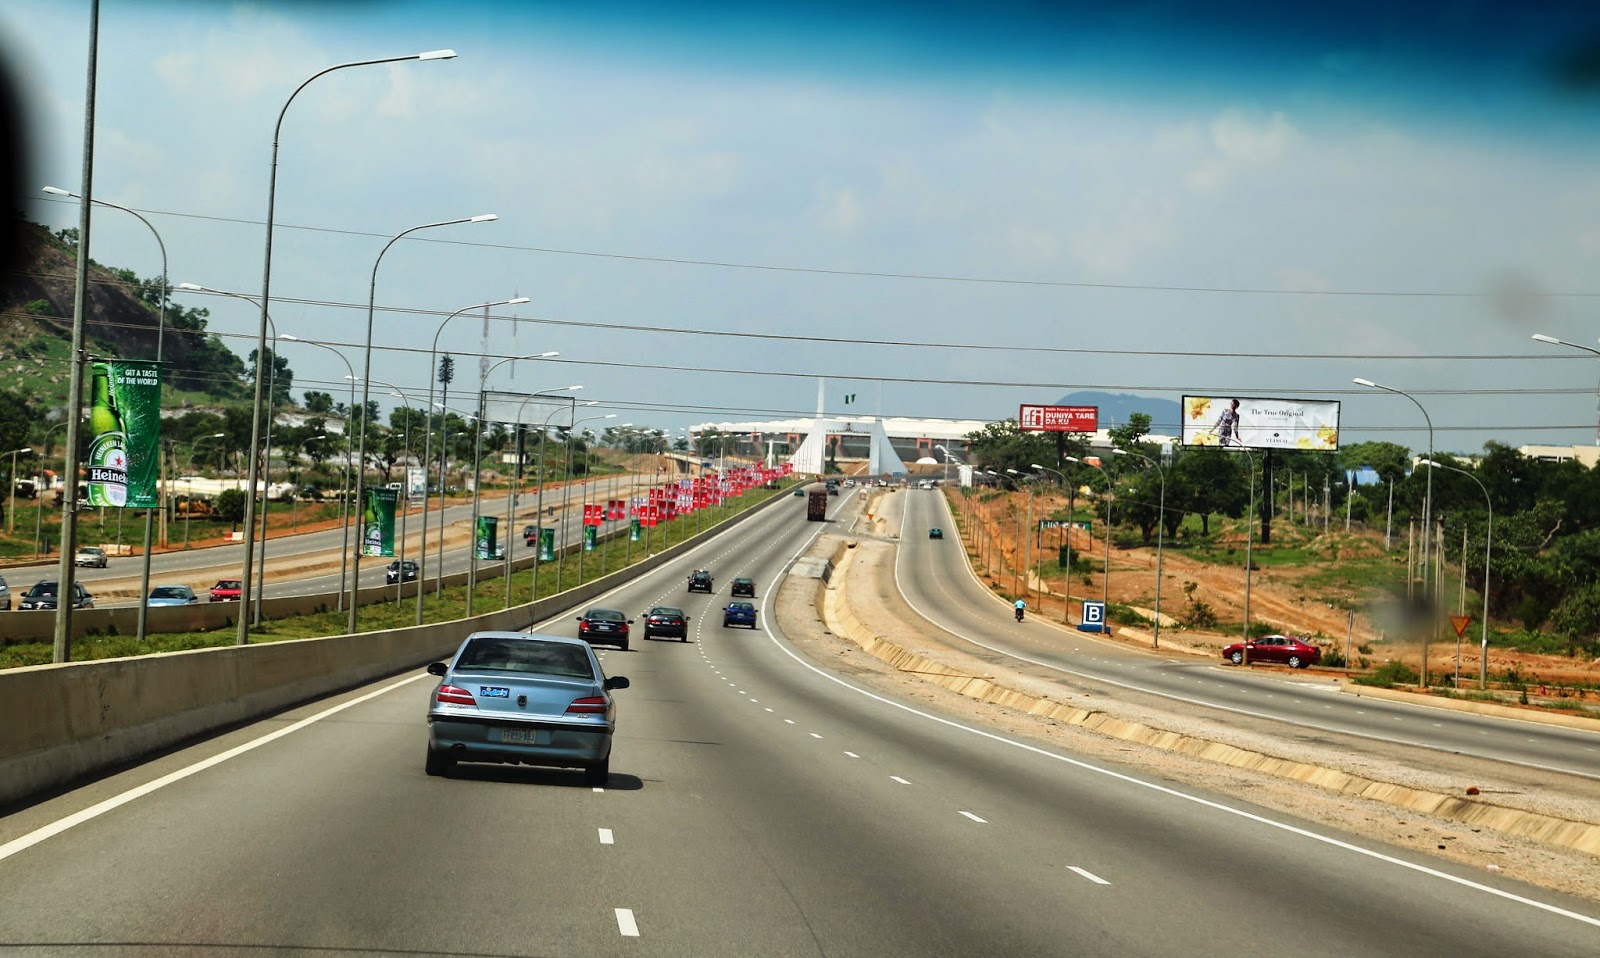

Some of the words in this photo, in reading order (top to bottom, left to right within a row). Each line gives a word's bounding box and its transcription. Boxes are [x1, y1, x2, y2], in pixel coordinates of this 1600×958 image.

[125, 369, 136, 377] GET
[136, 369, 141, 377] A
[142, 370, 158, 378] TASTE
[126, 377, 137, 385] THE
[137, 378, 158, 386] WORLD
[94, 439, 117, 461] HEINEKEN
[1088, 606, 1100, 621] B
